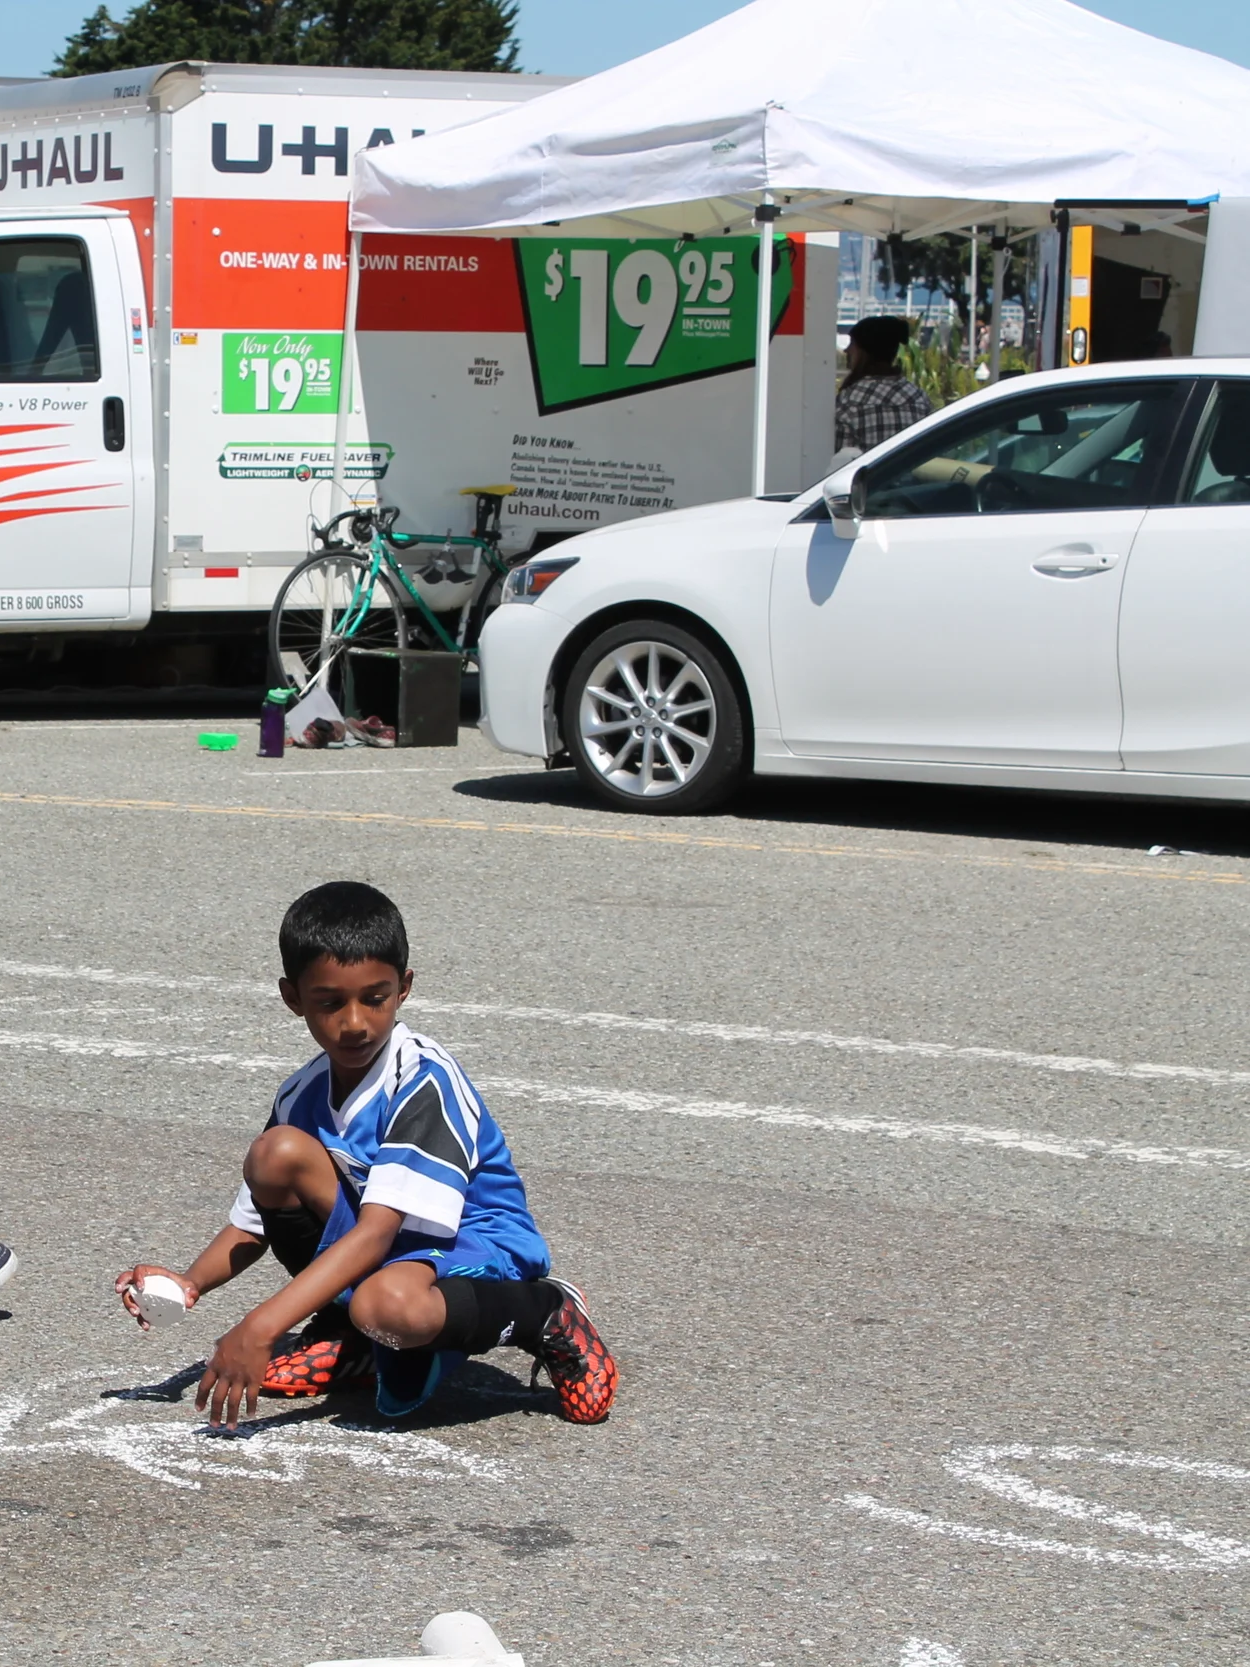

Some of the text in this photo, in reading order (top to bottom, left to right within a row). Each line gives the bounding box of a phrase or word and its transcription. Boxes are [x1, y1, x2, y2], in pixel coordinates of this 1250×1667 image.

[219, 251, 479, 272] ONE-WAY & IN-OWN RENTALS
[682, 318, 731, 330] IN-TOWN
[236, 335, 313, 361] Now Only
[474, 357, 498, 366] Where
[18, 398, 38, 410] V8
[42, 398, 88, 411] Power
[300, 452, 334, 462] FUEL
[226, 469, 290, 478] LIGHTWEIGHT
[508, 501, 599, 520] uhaul.com
[16, 596, 23, 610] 8
[25, 596, 43, 610] 600
[46, 594, 84, 610] GROSS
